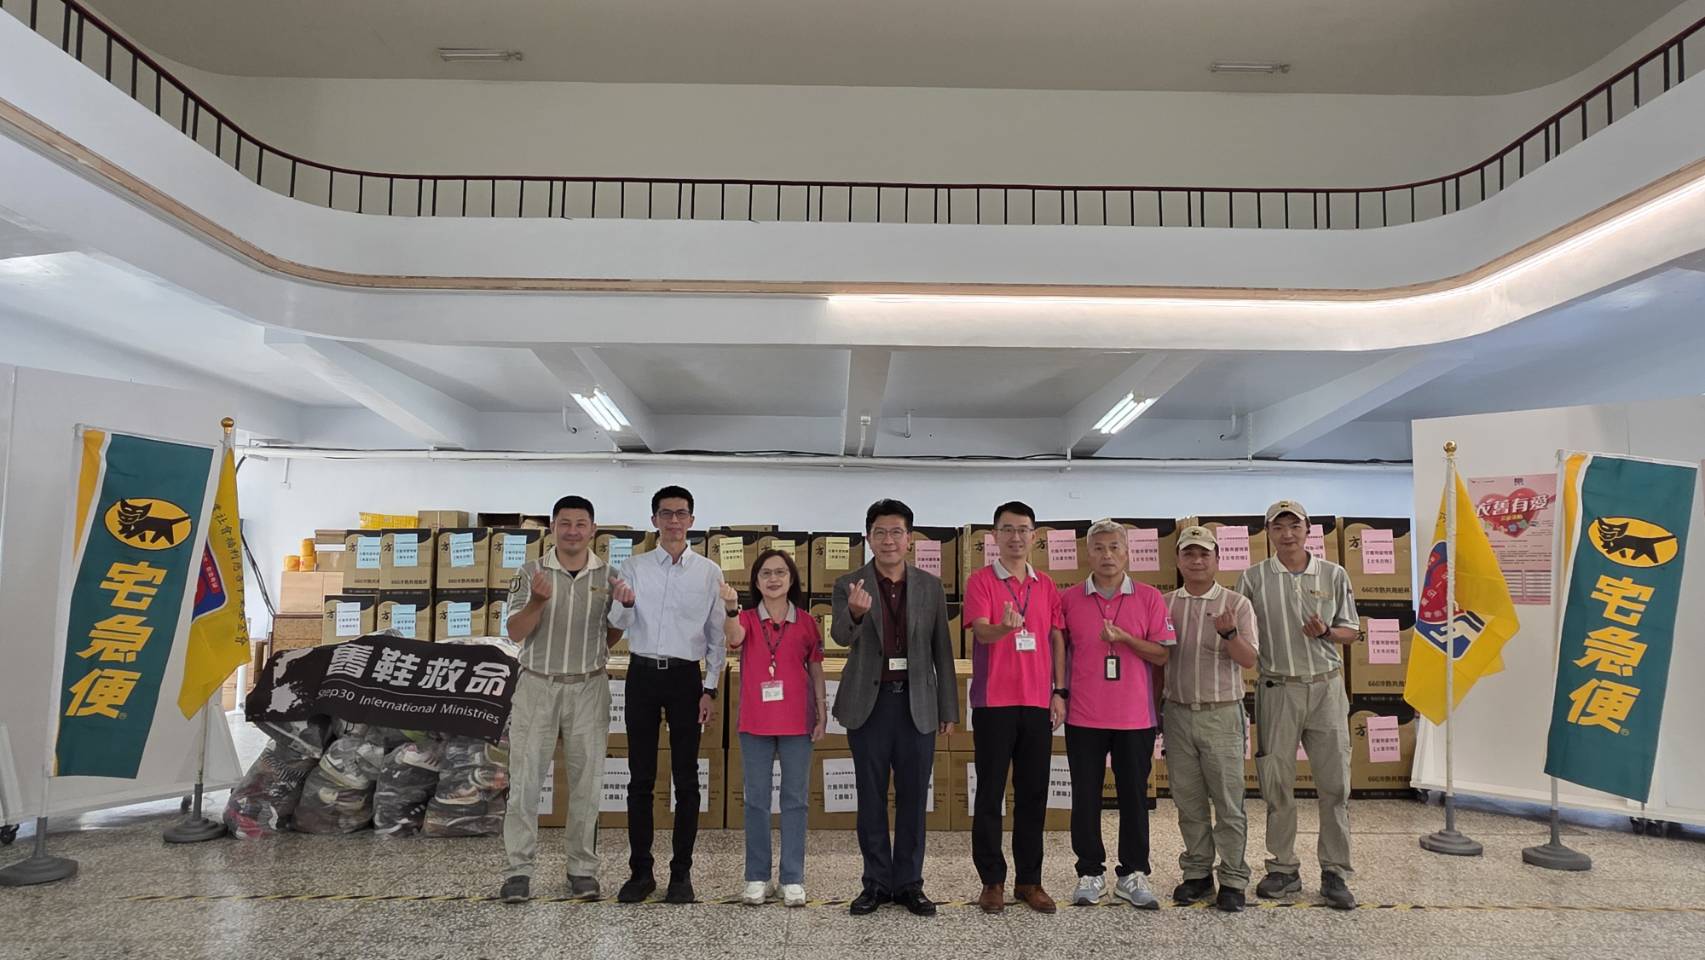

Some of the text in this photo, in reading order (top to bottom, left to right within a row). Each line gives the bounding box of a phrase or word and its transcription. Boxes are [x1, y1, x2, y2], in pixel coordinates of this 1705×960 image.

[349, 542, 357, 552] 方
[384, 542, 393, 552] 方
[441, 541, 450, 551] 方
[494, 542, 503, 552] 方
[975, 541, 985, 552] 方
[1036, 538, 1048, 550] 方
[1348, 536, 1361, 549] 方
[816, 543, 825, 556] 方
[326, 610, 336, 621] 方
[381, 610, 391, 621] 方
[439, 610, 449, 621] 方
[65, 561, 168, 719] 宅急便
[1567, 574, 1656, 734] 宅急便
[326, 643, 511, 697] 舊鞋救命
[359, 695, 437, 714] International
[439, 703, 501, 726] Ministries
[1354, 723, 1367, 737] 方
